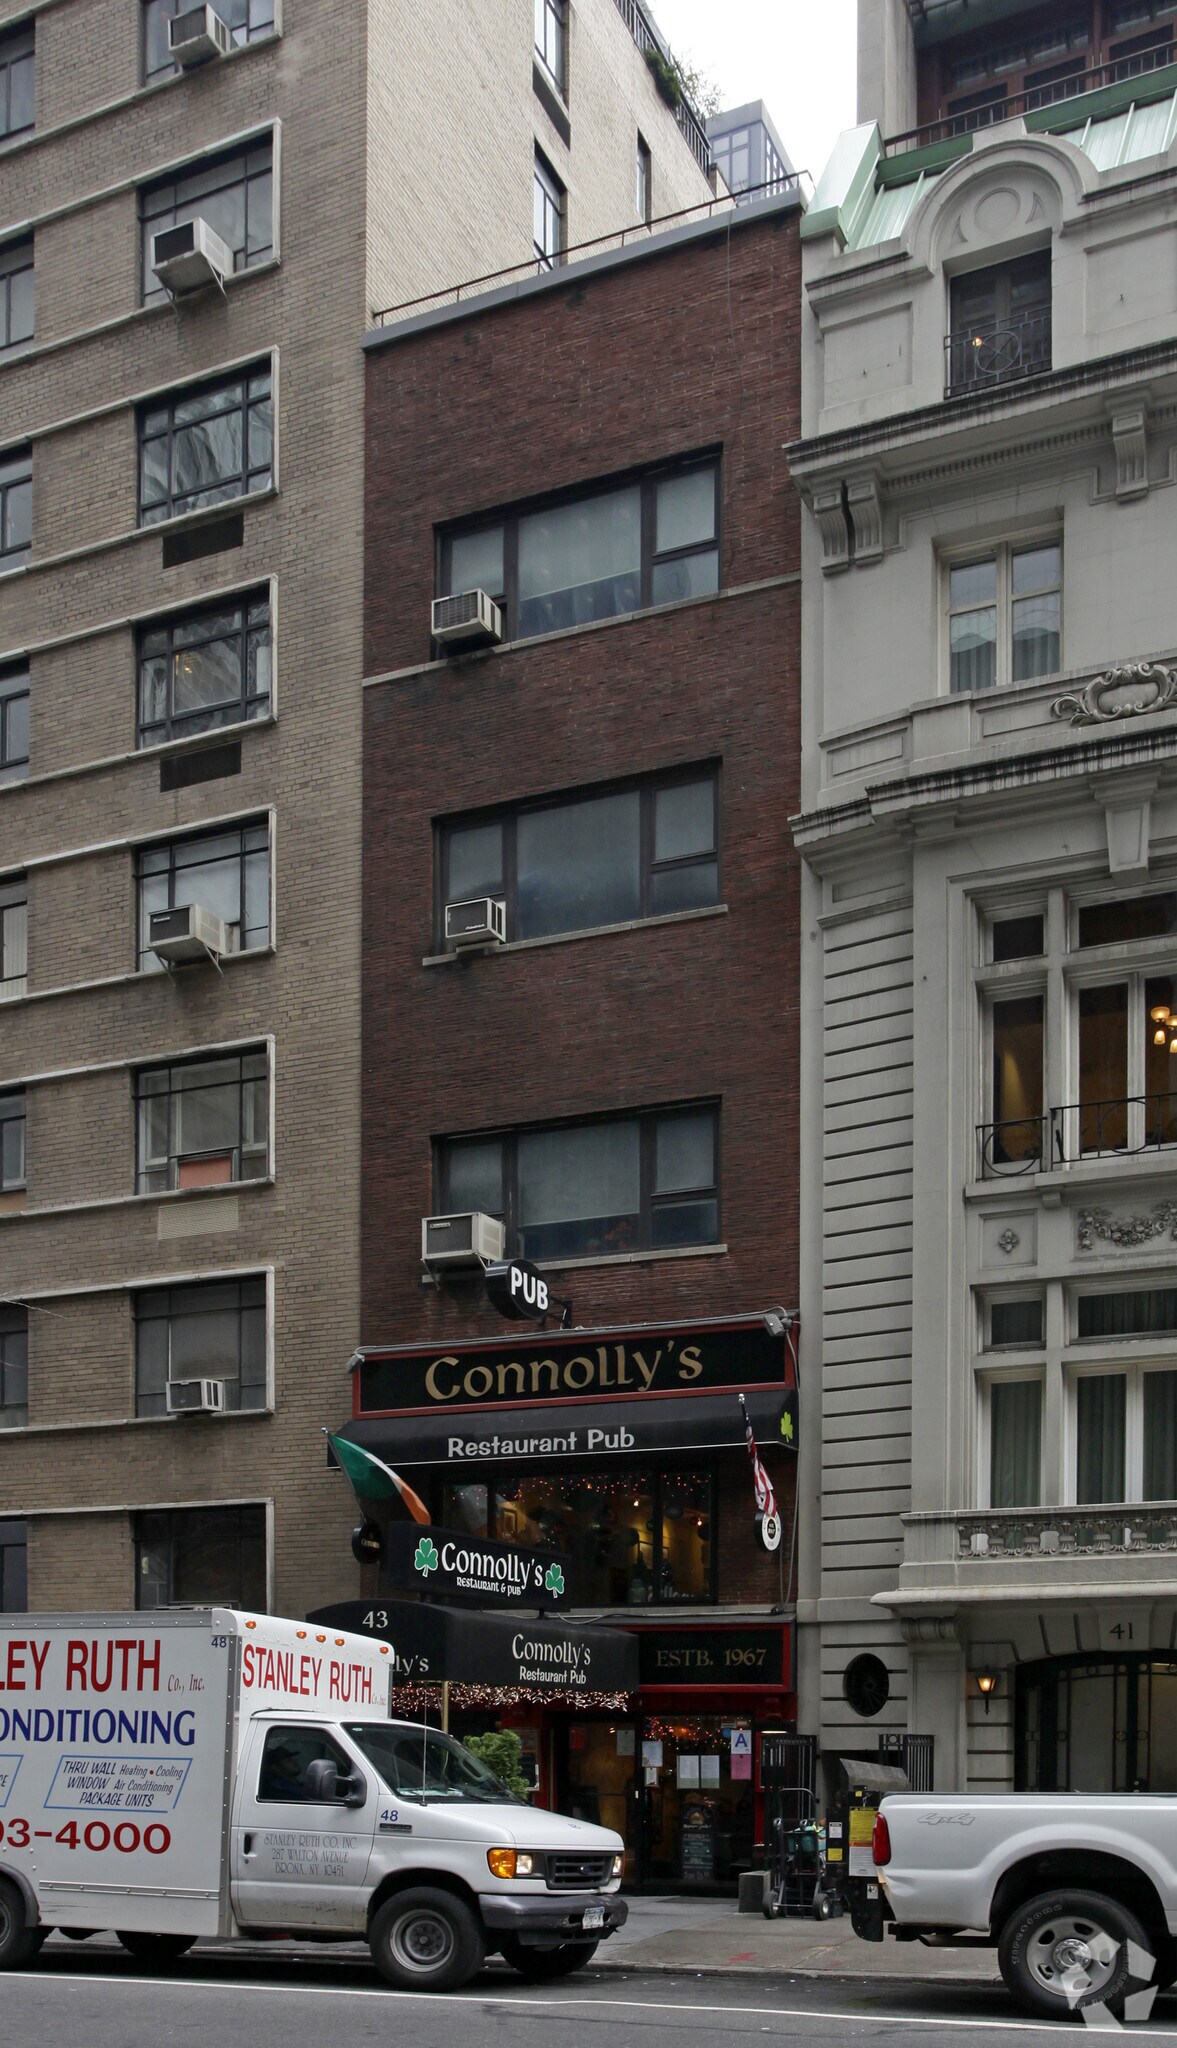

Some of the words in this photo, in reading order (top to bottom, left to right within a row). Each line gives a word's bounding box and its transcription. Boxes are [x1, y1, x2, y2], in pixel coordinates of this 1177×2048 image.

[511, 1266, 549, 1310] PUB
[424, 1340, 703, 1400] Connolly's
[448, 1432, 577, 1458] Restaurant
[587, 1426, 635, 1449] Pub
[441, 1542, 544, 1589] Connolly's
[501, 1582, 506, 1593] &
[362, 1610, 389, 1629] 43
[1109, 1622, 1134, 1640] 41
[211, 1636, 227, 1648] 48
[512, 1633, 591, 1669] Connolly's
[66, 1640, 160, 1692] RUTH
[189, 1673, 205, 1691] Inc.
[656, 1649, 714, 1667] ESTB.
[724, 1648, 767, 1666] 1967
[242, 1643, 322, 1697] STANLEY
[329, 1660, 373, 1704] RUTH
[520, 1665, 568, 1684] Restaurant
[570, 1669, 587, 1684] Pub
[734, 1732, 748, 1748] A
[63, 1761, 88, 1775] THRU
[91, 1762, 117, 1775] WALL
[119, 1764, 148, 1778] Heating
[155, 1765, 184, 1780] Cooling
[67, 1776, 110, 1790] WINDOW
[113, 1779, 126, 1790] Air
[127, 1779, 174, 1795] Conditioning
[79, 1791, 124, 1806] PACKAGE
[125, 1793, 155, 1807] UNITS
[380, 1809, 399, 1822] 48
[917, 1812, 976, 1826] 4x4
[0, 1817, 171, 1855] 3-4000
[264, 1833, 297, 1847] STANLEY
[299, 1835, 320, 1848] RUTH
[272, 1848, 285, 1860] 287
[287, 1848, 319, 1862] WALTON
[320, 1850, 349, 1863] AVENUE
